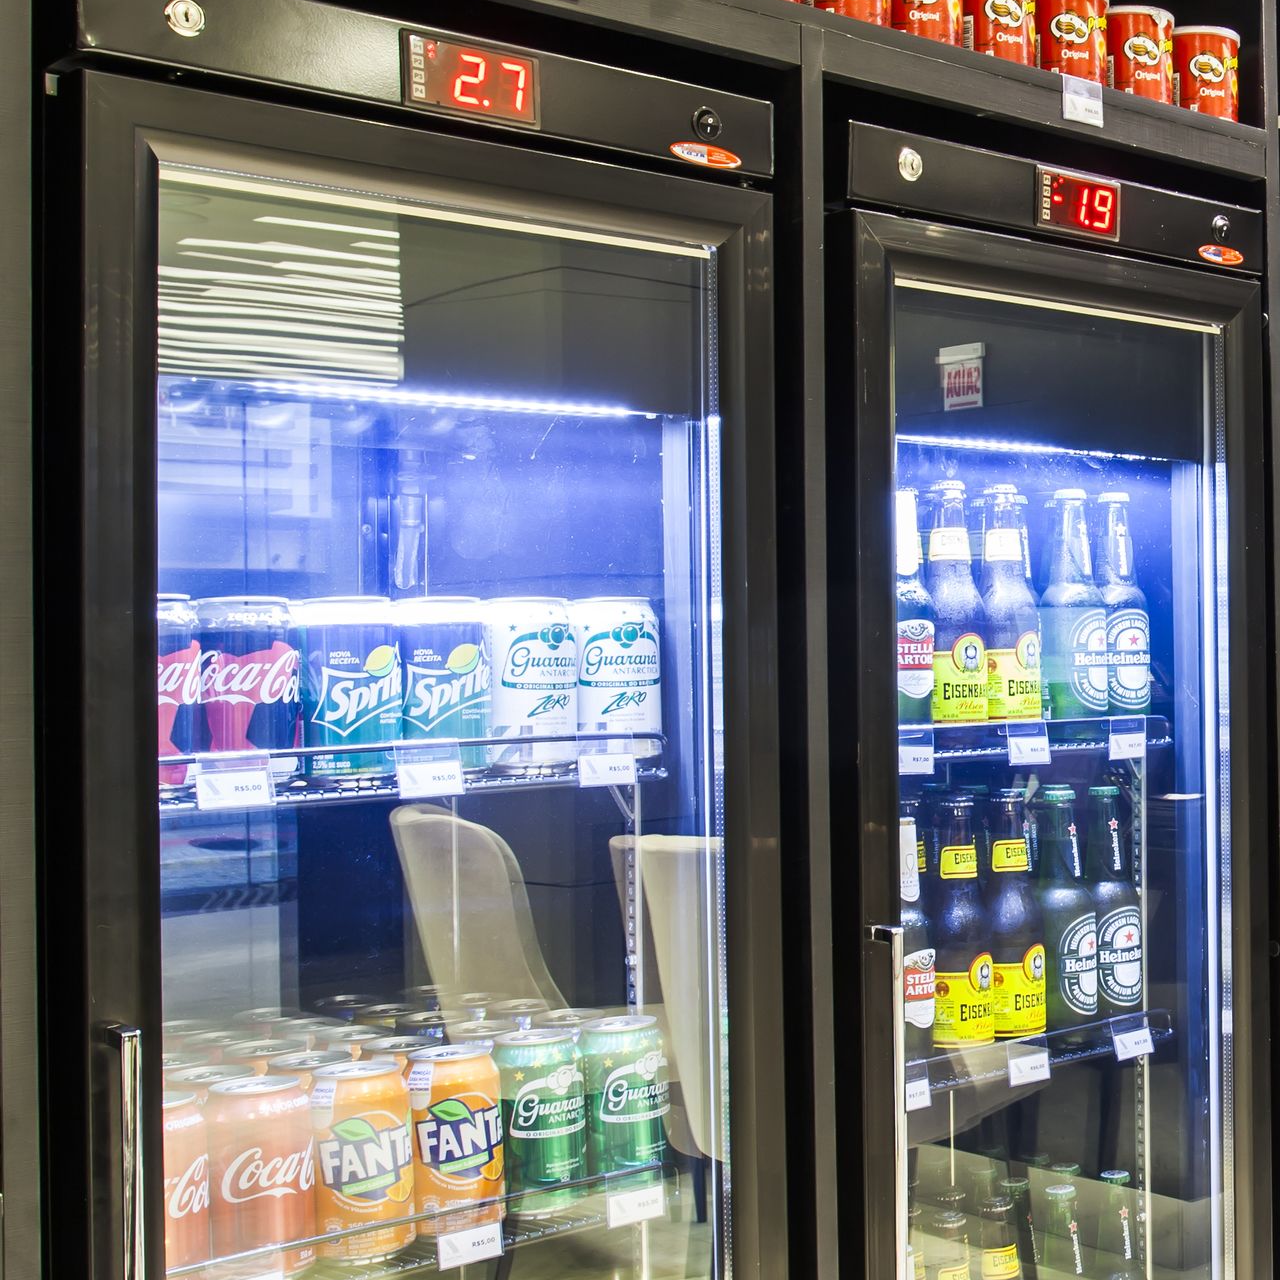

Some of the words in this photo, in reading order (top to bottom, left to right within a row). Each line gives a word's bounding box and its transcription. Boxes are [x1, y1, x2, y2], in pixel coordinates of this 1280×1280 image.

[909, 9, 940, 22] Original
[996, 31, 1023, 45] Original
[1061, 48, 1089, 61] Original
[454, 53, 526, 111] 2.7
[1135, 70, 1160, 82] Original
[1200, 86, 1225, 98] Original
[329, 650, 352, 658] NOVA
[413, 648, 434, 656] NOVA
[329, 657, 361, 665] RECEITA
[413, 655, 442, 663] RECEITA
[585, 646, 658, 676] Guaraná
[897, 654, 933, 665] ARTOI
[1104, 651, 1150, 666] Heineke
[409, 658, 491, 719] Sprite
[608, 765, 630, 773] R$5,00
[432, 773, 457, 782] R$5,00
[234, 784, 262, 793] R$5,00
[1110, 829, 1121, 870] Heineken
[1070, 835, 1081, 877] Heineken
[1099, 947, 1142, 964] Heineke
[905, 984, 935, 997] ARTO
[472, 1236, 496, 1248] R$5,00
